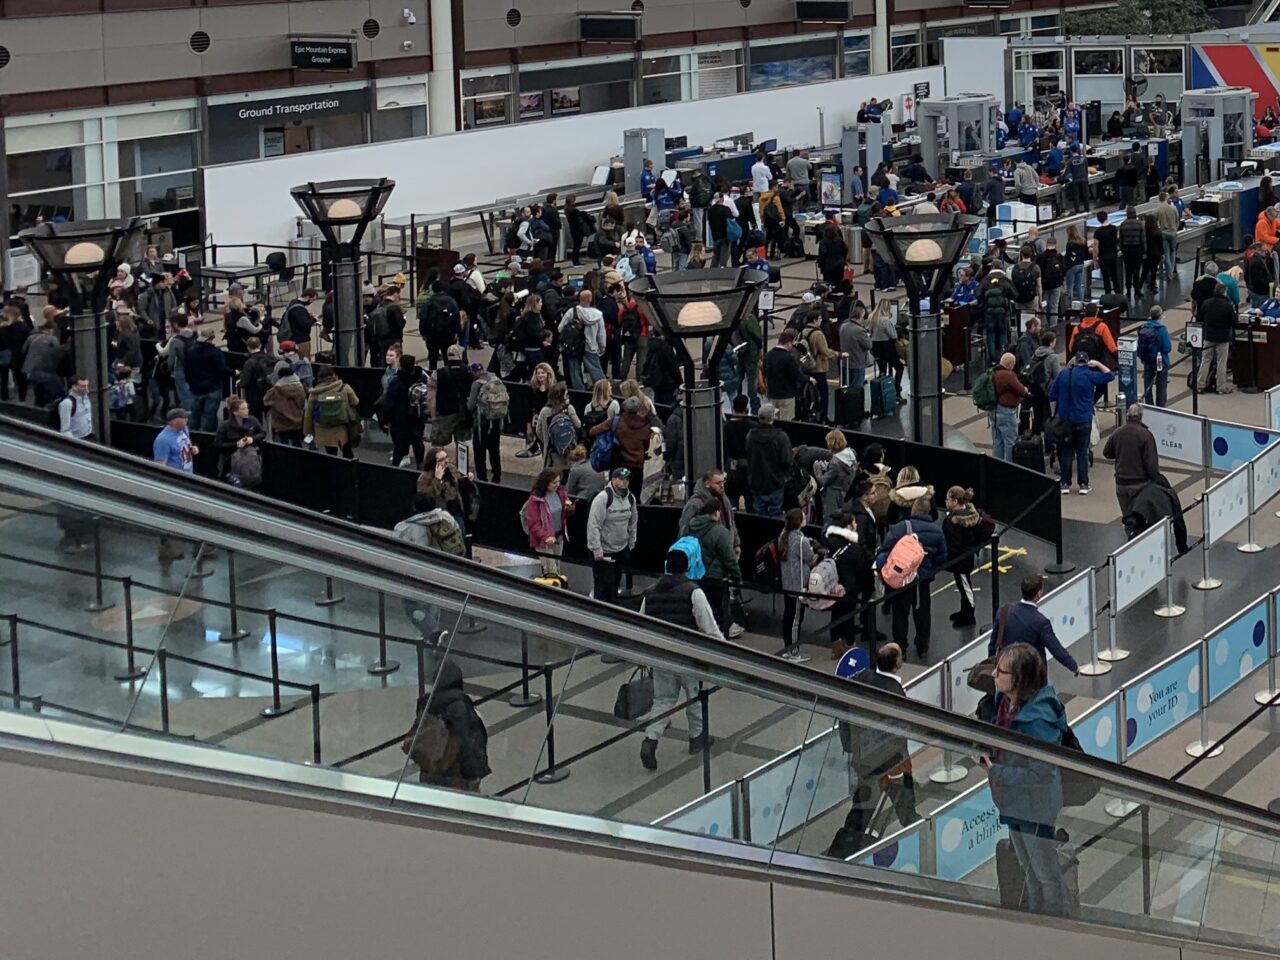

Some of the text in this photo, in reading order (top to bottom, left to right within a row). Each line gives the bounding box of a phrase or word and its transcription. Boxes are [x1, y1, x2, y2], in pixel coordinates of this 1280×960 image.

[294, 46, 305, 54] Epic
[311, 56, 331, 64] Groome
[239, 99, 339, 118] Ground Transportation
[1161, 440, 1183, 449] CLEAR
[1149, 680, 1178, 705] You are
[1148, 695, 1179, 727] your ID
[962, 804, 997, 836] Access
